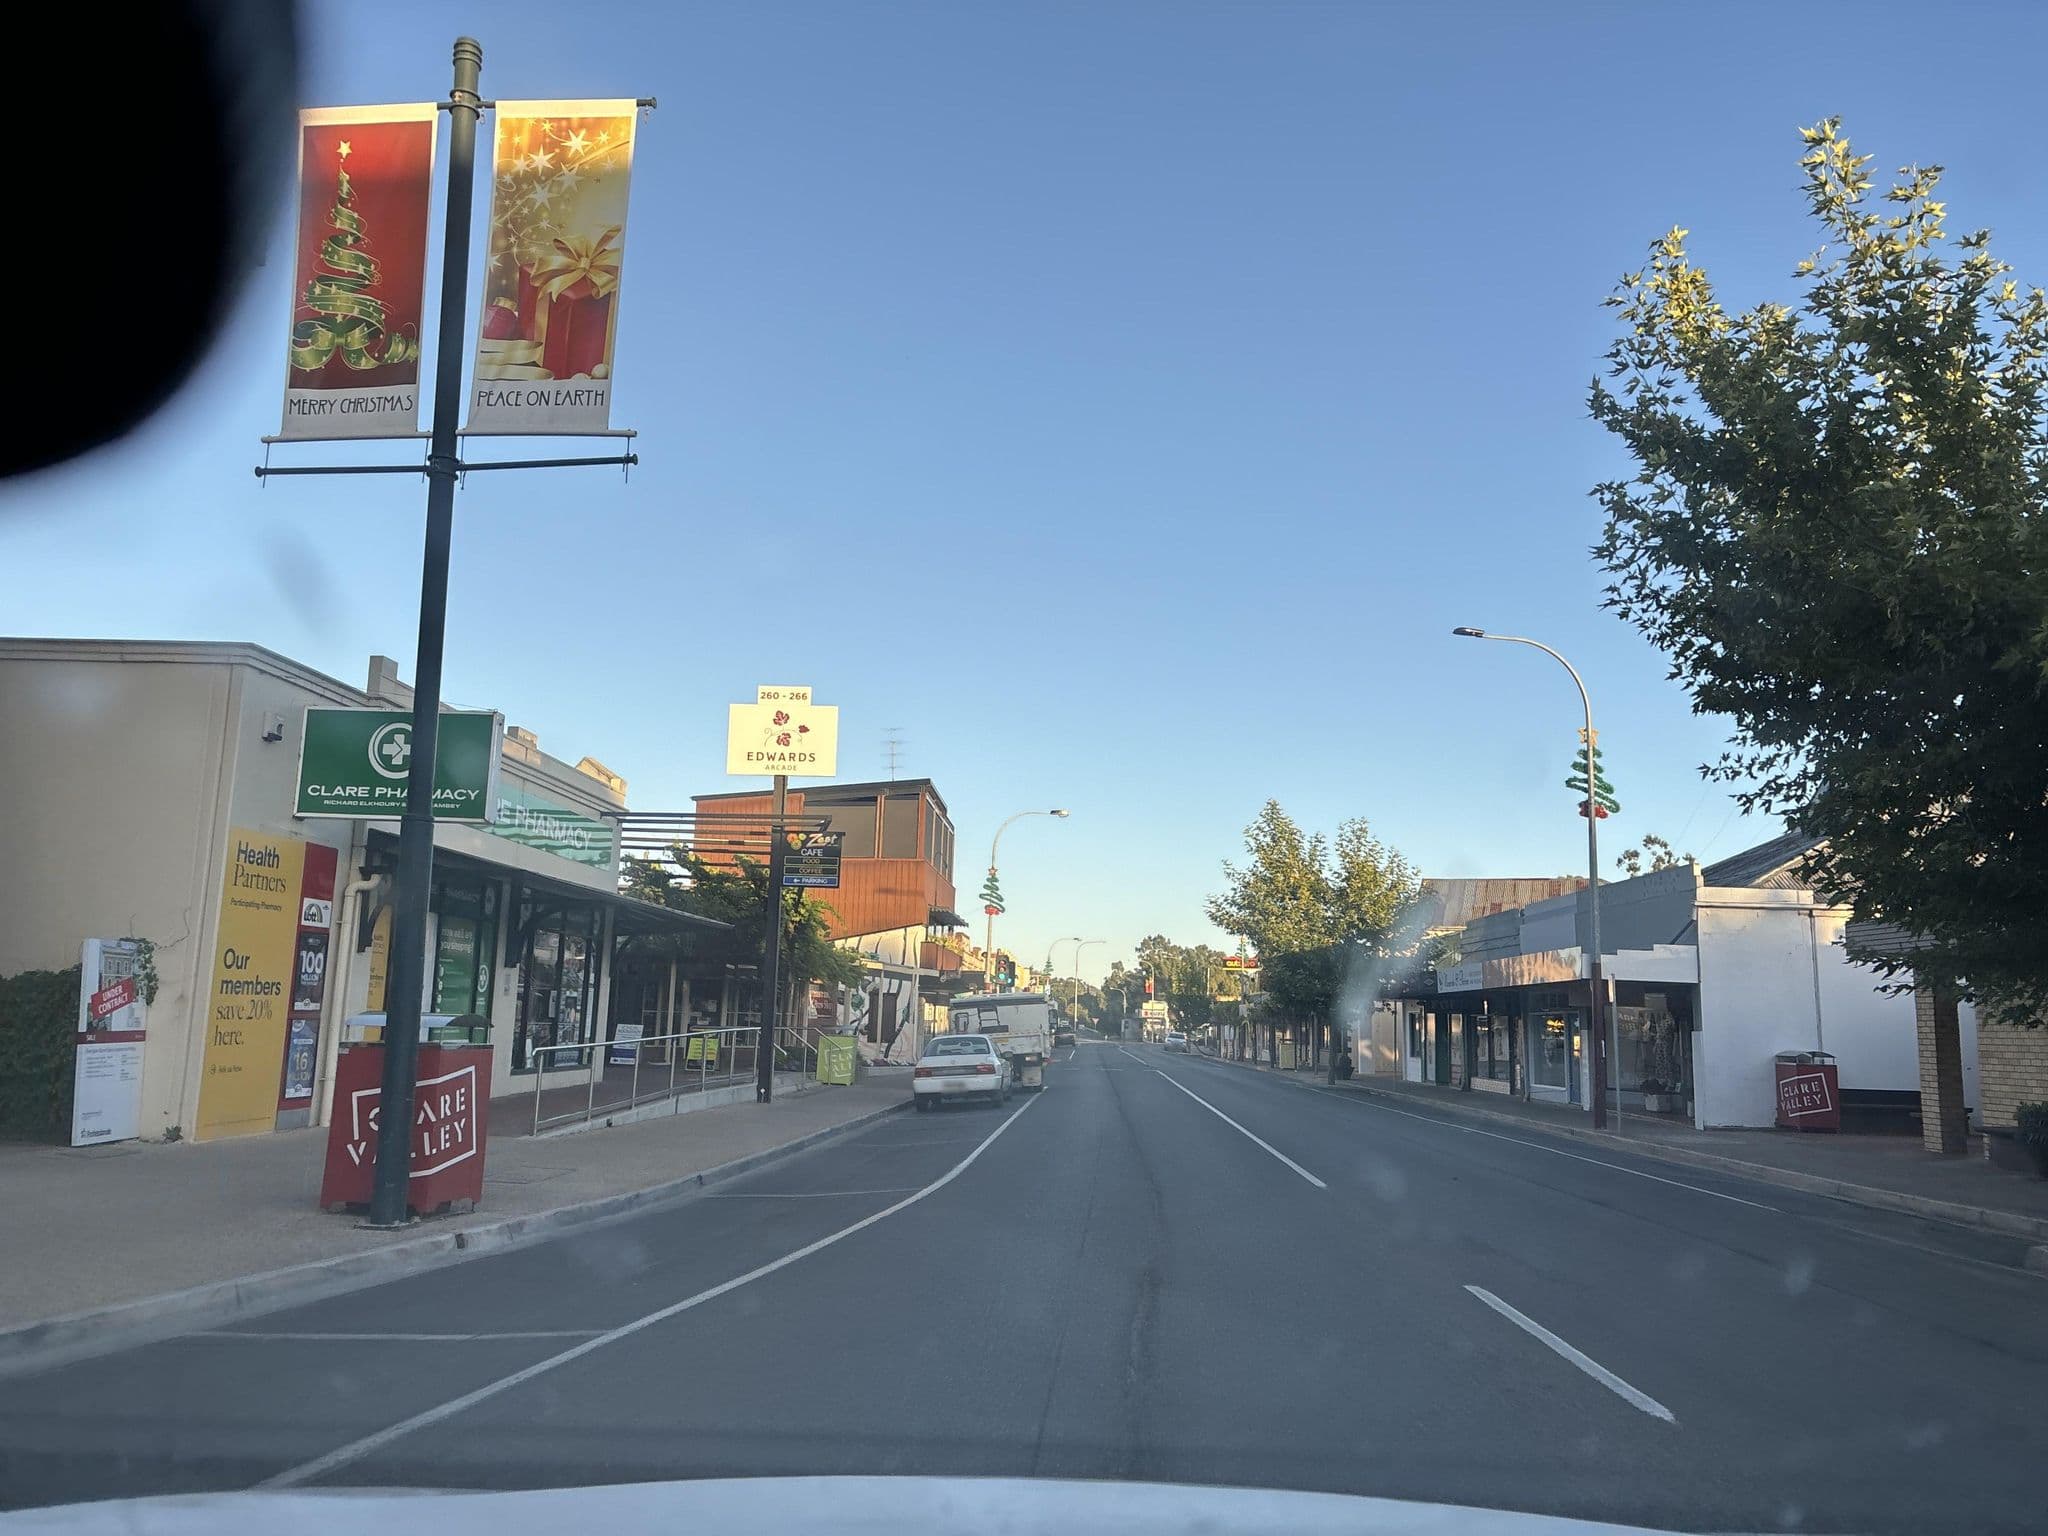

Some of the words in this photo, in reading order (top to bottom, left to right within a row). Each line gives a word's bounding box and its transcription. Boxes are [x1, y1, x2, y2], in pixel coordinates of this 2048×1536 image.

[289, 397, 336, 415] MERRY
[340, 394, 414, 414] CHRISTMAS
[477, 391, 523, 407] PEACE
[526, 390, 551, 407] ON
[554, 390, 605, 406] EARTH
[760, 691, 779, 700] 260
[789, 692, 808, 701] 266
[747, 751, 816, 762] EDWARDS
[307, 784, 369, 798] CLARE
[374, 786, 480, 800] PHAMACY
[516, 804, 591, 850] PHARMACY
[236, 841, 280, 869] Health
[233, 864, 286, 892] Partners
[223, 948, 250, 970] Our
[301, 951, 324, 973] 100
[102, 985, 123, 1001] UNDER
[219, 975, 281, 996] members
[98, 993, 129, 1014] CONTRACT
[216, 1005, 246, 1020] save
[247, 999, 273, 1020] 20%
[213, 1025, 245, 1046] here.
[295, 1052, 308, 1072] 16
[1784, 1081, 1820, 1097] CLARE
[369, 1087, 466, 1131] CARE
[1781, 1094, 1821, 1110] VALLEY
